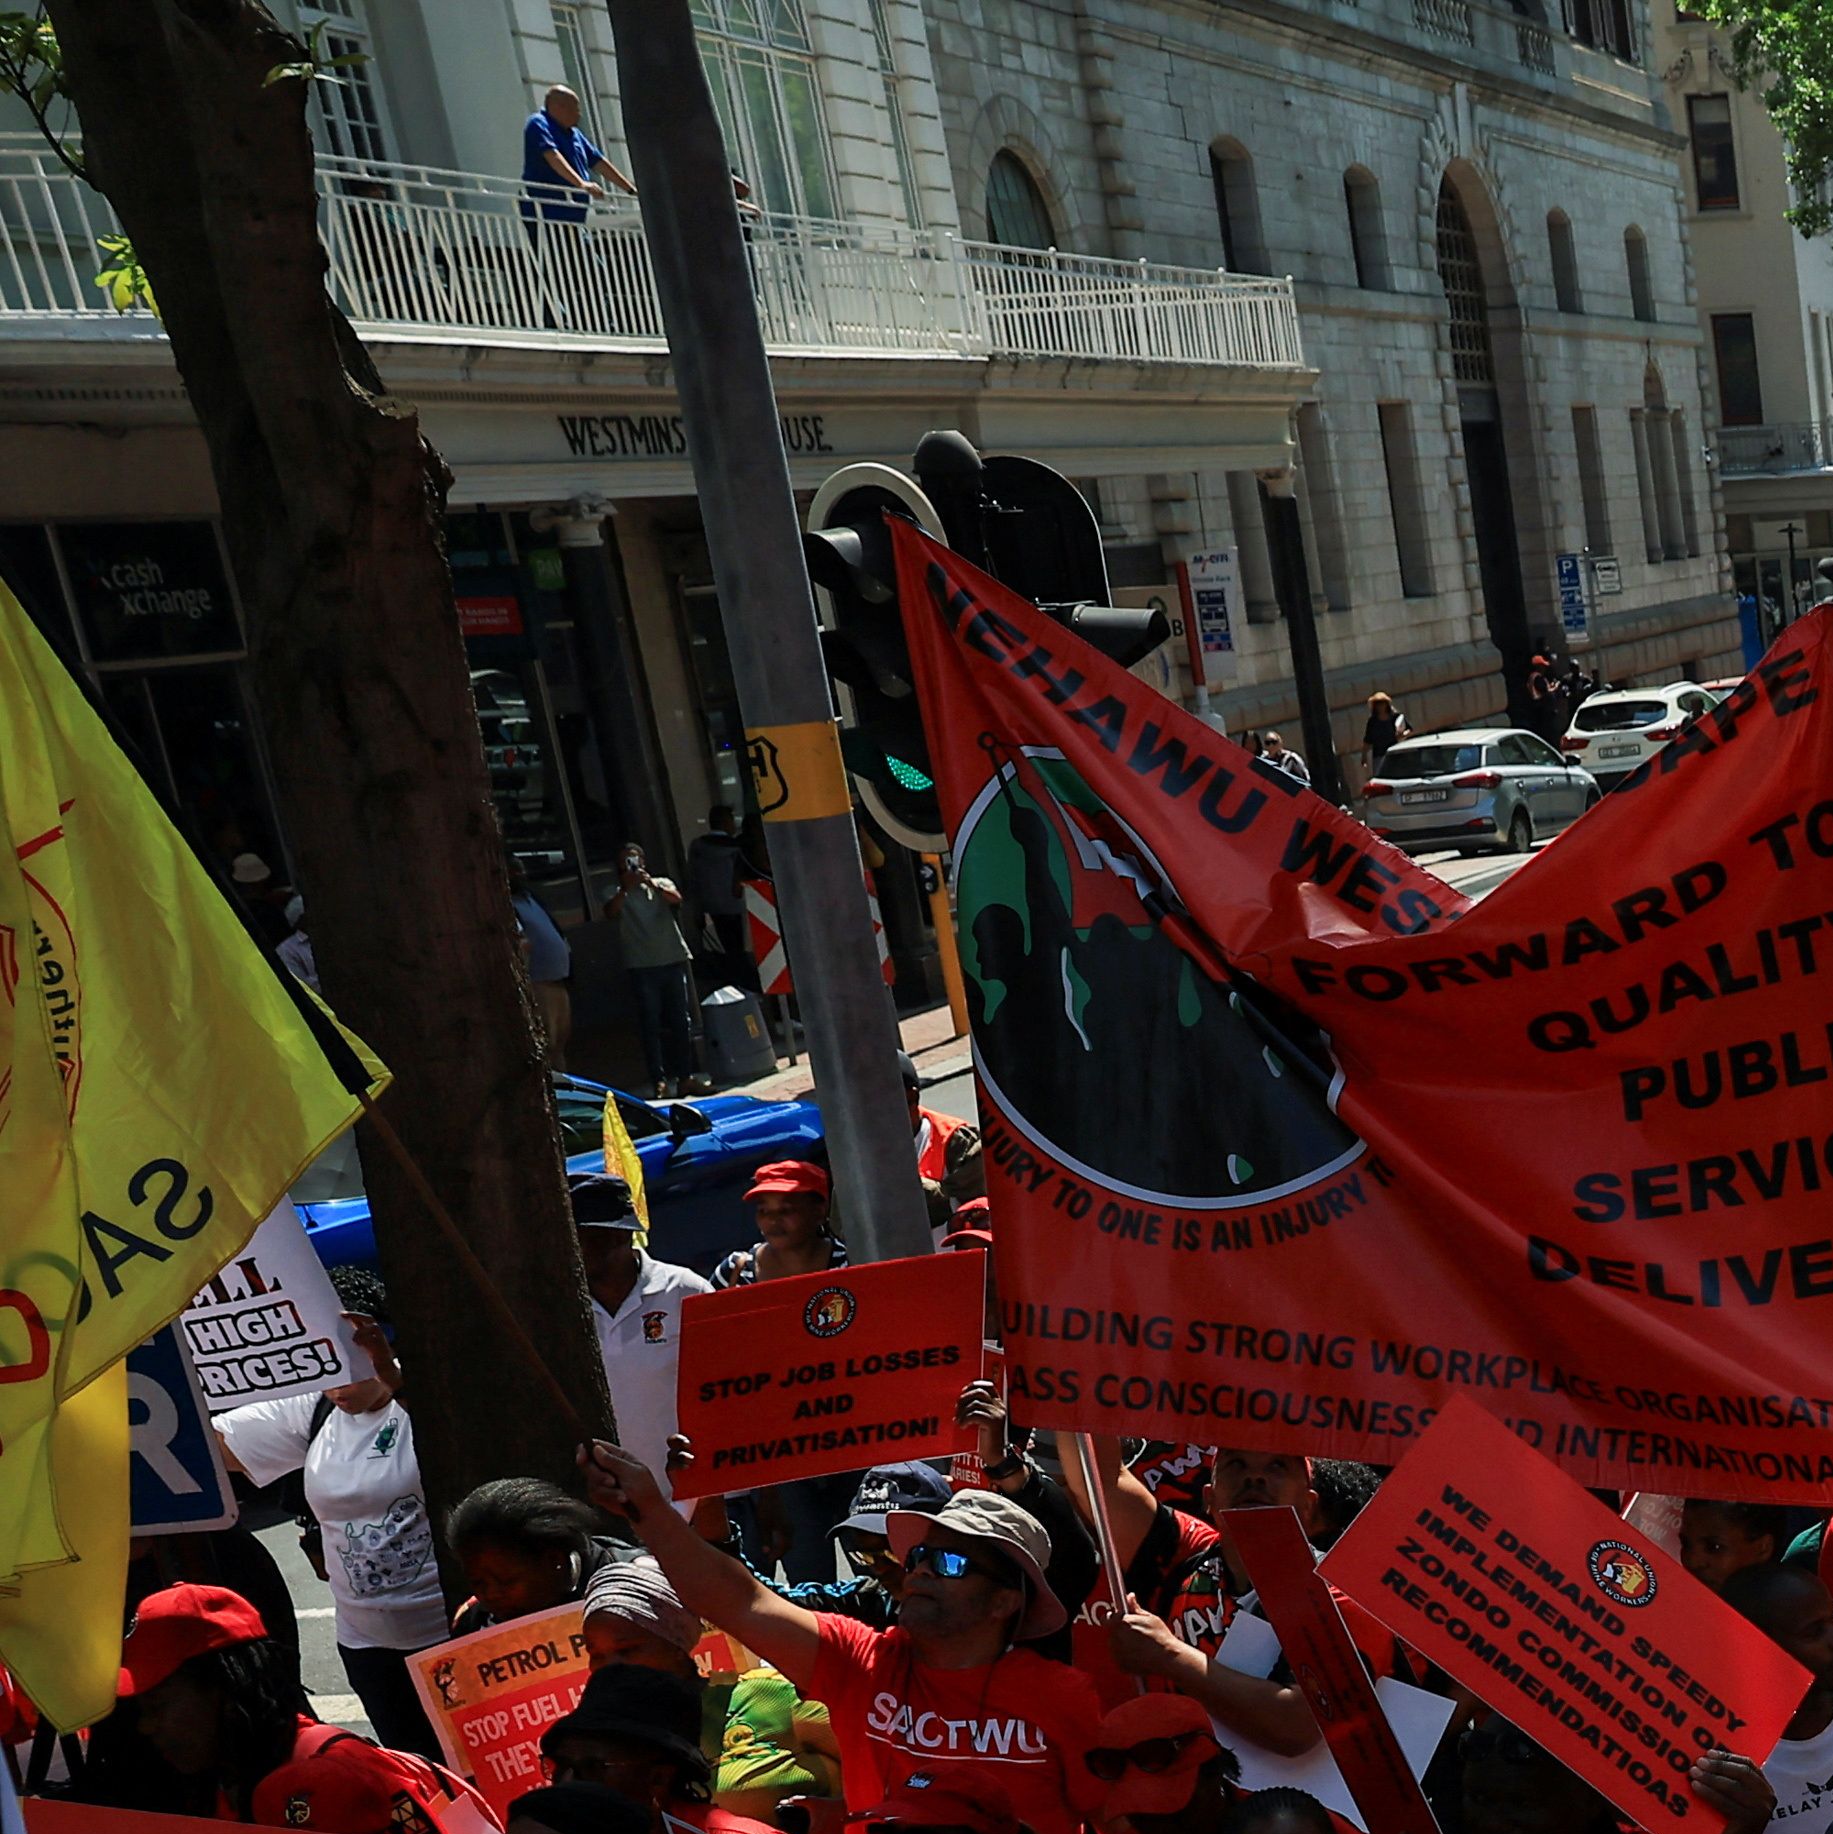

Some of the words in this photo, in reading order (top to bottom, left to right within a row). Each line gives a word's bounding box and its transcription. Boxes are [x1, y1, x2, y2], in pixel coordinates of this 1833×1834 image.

[110, 557, 165, 588] cash
[119, 588, 214, 620] xchange
[1291, 860, 1728, 1004] FORWARD
[1097, 1203, 1161, 1246] ONE
[1172, 1219, 1200, 1251] IS
[1209, 1217, 1252, 1252] AN
[187, 1301, 305, 1354] HIGH
[699, 1372, 771, 1402] STOP
[780, 1362, 836, 1389] JOB
[845, 1344, 961, 1378] LOSSES
[1184, 1319, 1356, 1370] STRONG
[1369, 1337, 1614, 1407] WORKPLACE
[794, 1392, 854, 1420] AND
[711, 1415, 940, 1470] PRIVATISATION!
[1439, 1484, 1493, 1533] WE
[1414, 1507, 1688, 1729] IMPLEMENTATION
[866, 1690, 1048, 1756] SACTWU
